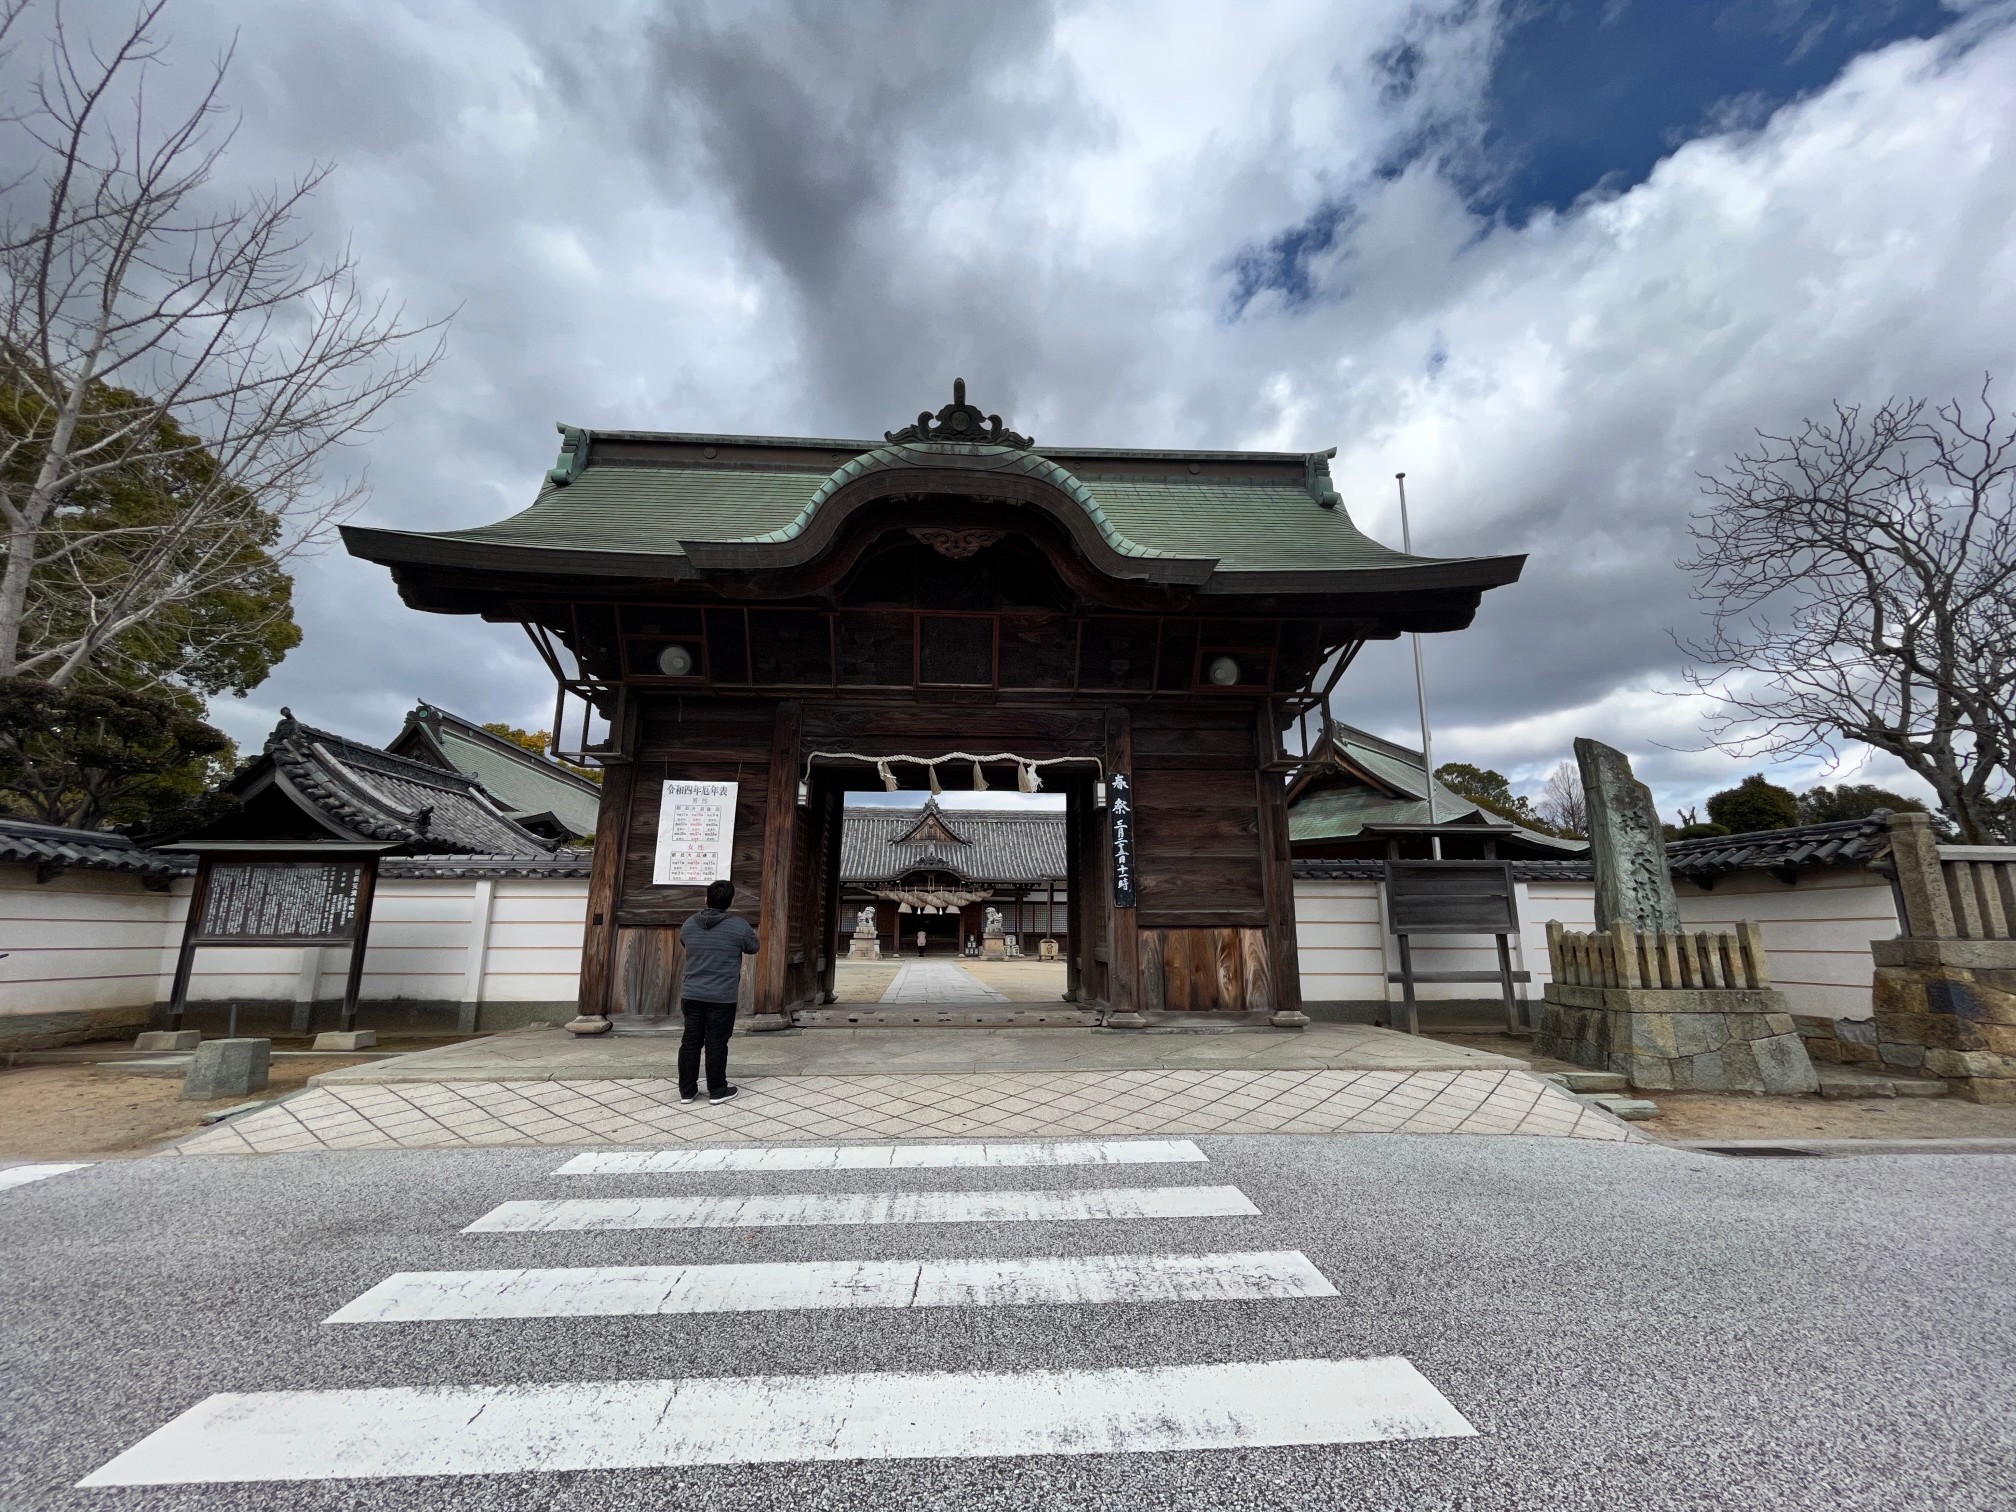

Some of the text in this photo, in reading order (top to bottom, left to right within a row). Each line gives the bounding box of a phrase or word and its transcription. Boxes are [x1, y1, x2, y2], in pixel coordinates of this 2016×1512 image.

[667, 784, 728, 797] 令和四年厄年表
[1112, 774, 1131, 891] 春祭 三月二十五日十一時
